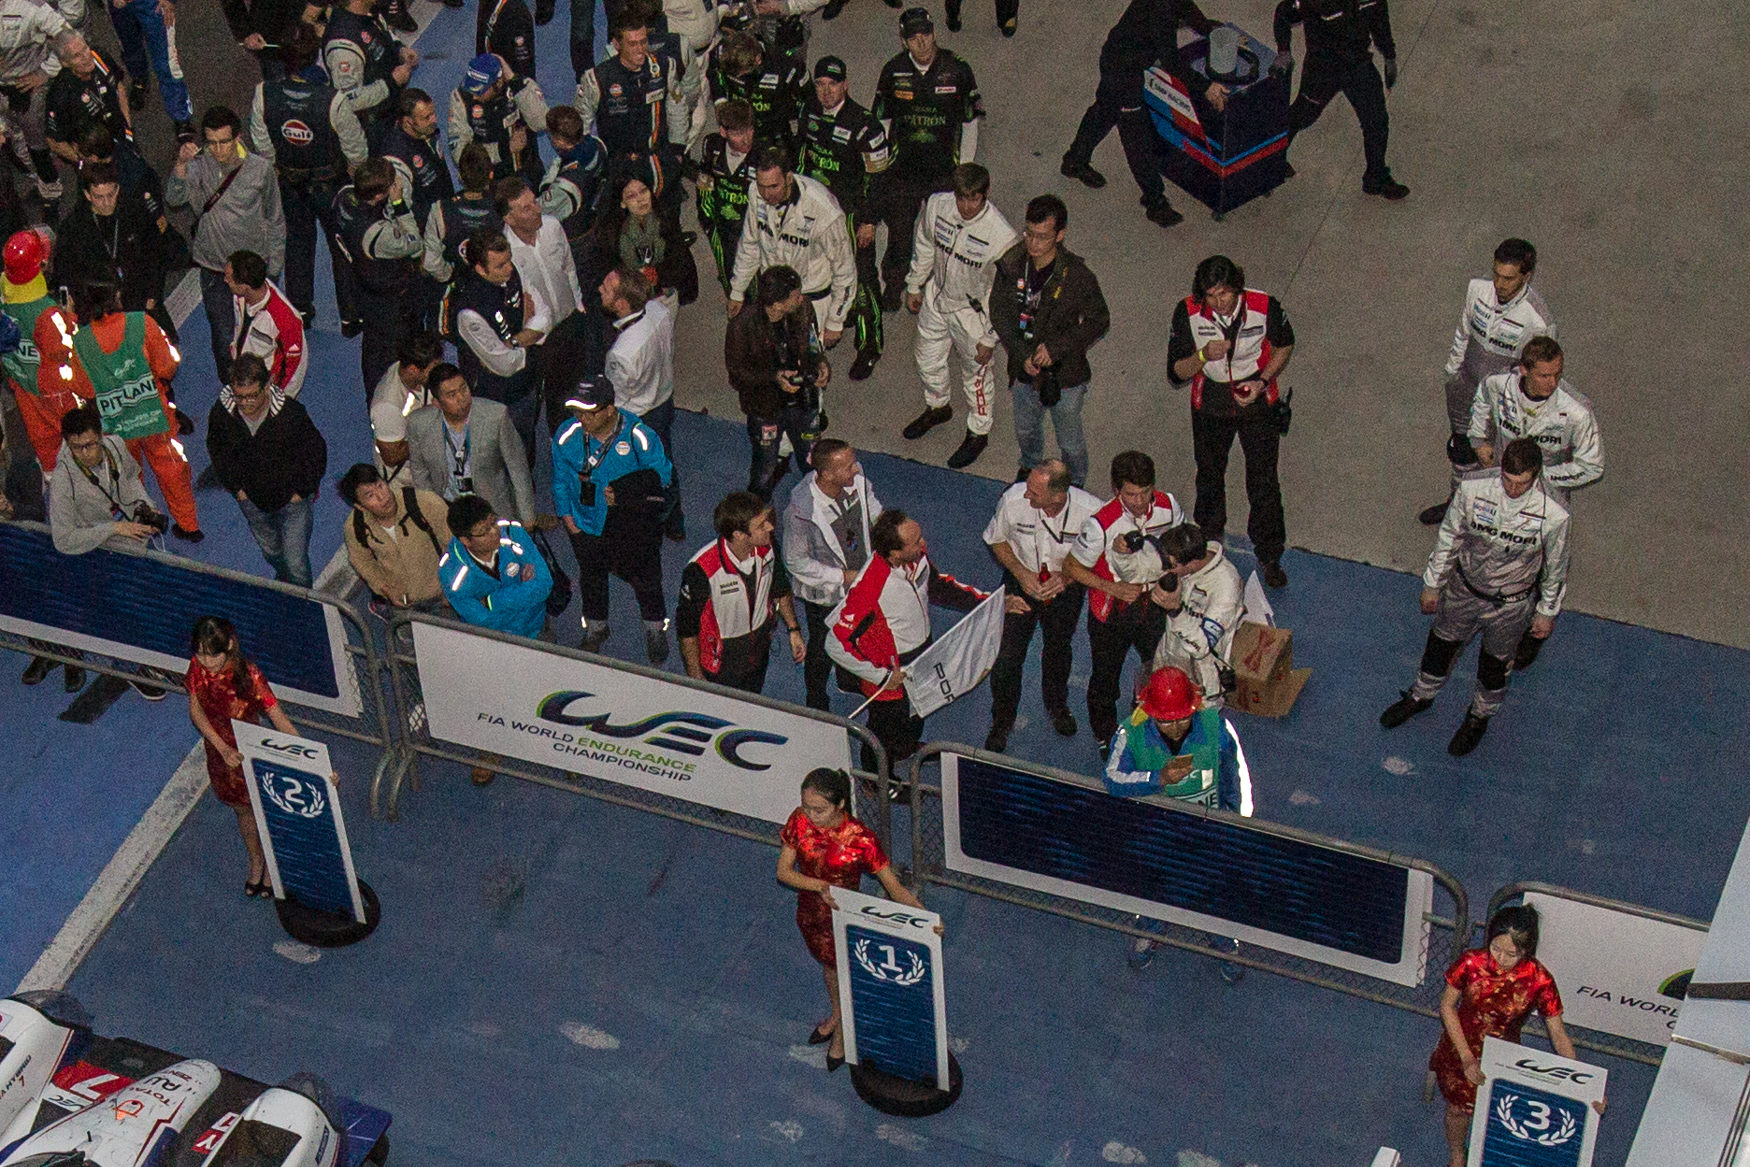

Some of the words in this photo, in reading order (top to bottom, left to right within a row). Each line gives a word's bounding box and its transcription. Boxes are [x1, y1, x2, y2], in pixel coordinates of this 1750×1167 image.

[954, 253, 983, 269] MORI
[100, 394, 123, 412] PIT
[1530, 433, 1563, 446] MORI
[1499, 533, 1538, 548] MORI
[477, 712, 505, 727] FIA
[511, 720, 574, 743] WORLD
[577, 736, 697, 772] ENDURANCE
[536, 690, 789, 771] WEC
[261, 738, 318, 759] WEC
[552, 742, 692, 782] CHAMPIONSHIP
[282, 776, 305, 805] 2
[861, 906, 929, 928] WEC
[878, 945, 903, 972] 1
[1576, 985, 1612, 1002] FIA
[1619, 995, 1679, 1018] WORL
[6, 1054, 32, 1093] HYBRID
[1515, 1059, 1594, 1084] WEC
[69, 1072, 121, 1100] 7
[129, 1085, 172, 1107] TOTAL
[1523, 1100, 1551, 1130] 3
